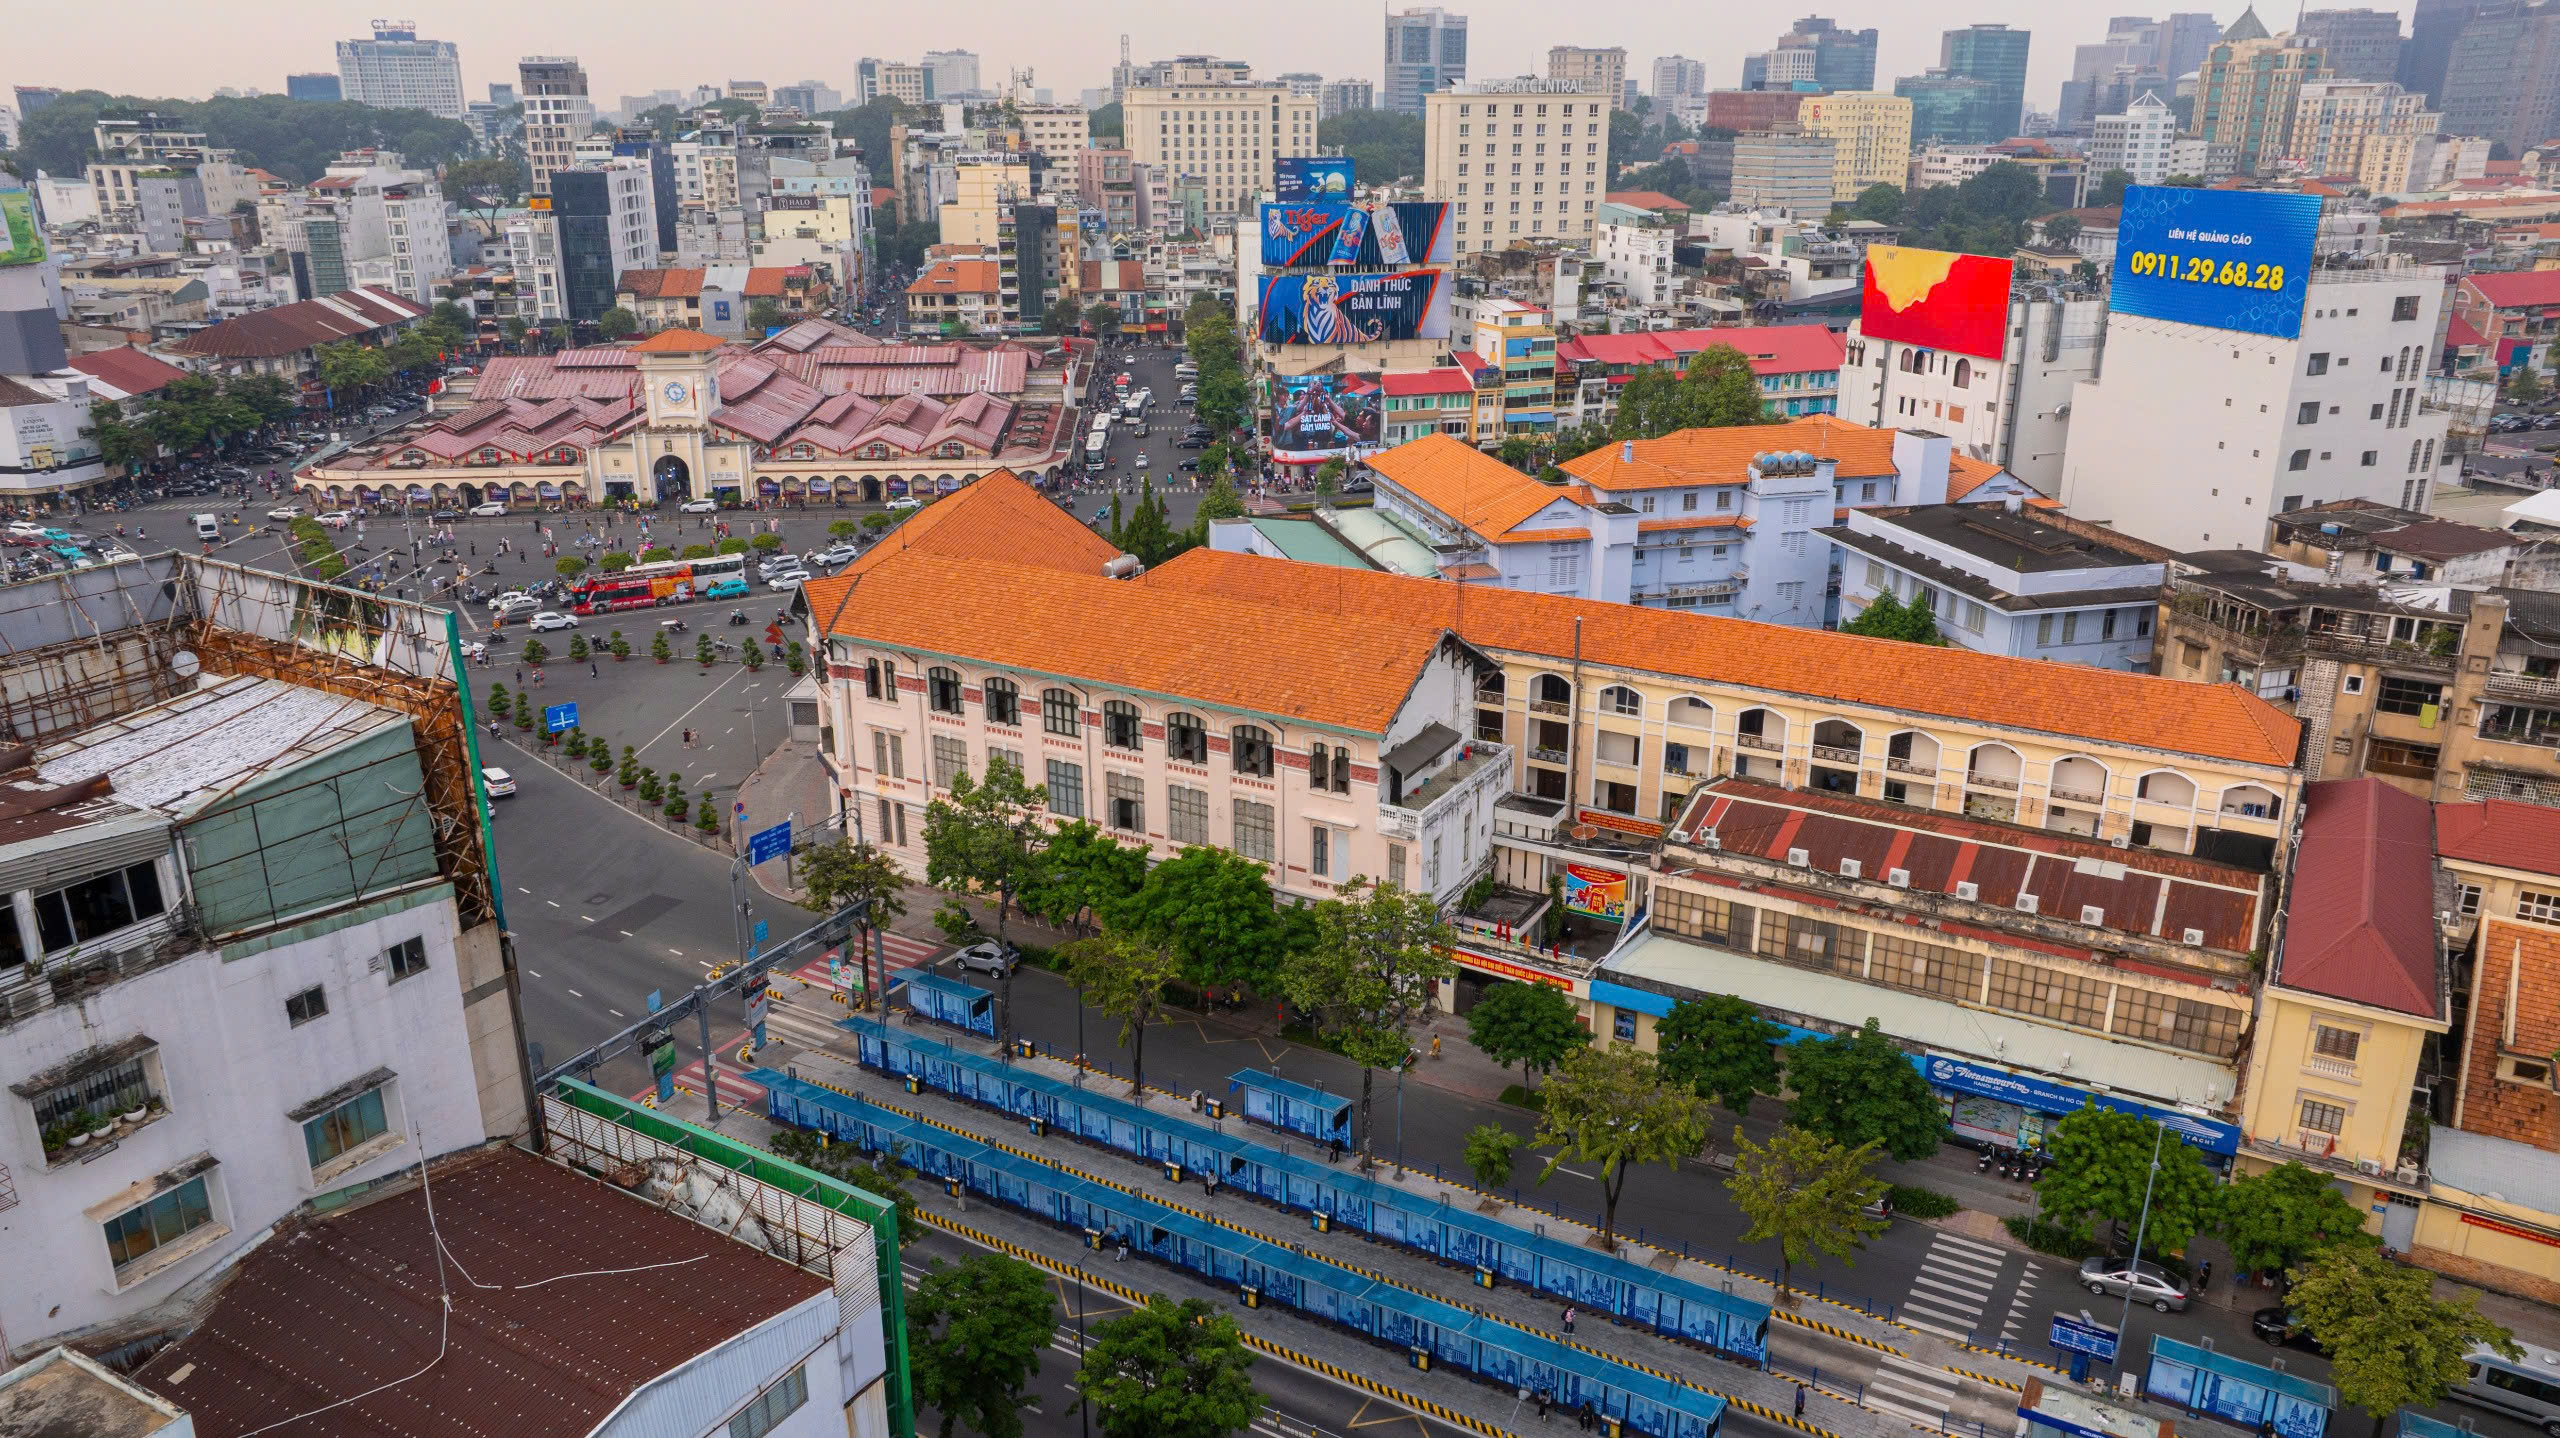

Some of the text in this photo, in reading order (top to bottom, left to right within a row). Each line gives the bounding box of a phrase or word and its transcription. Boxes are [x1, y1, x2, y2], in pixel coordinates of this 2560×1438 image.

[1480, 79, 1585, 93] LIBERTY CENTRAL
[1285, 208, 1330, 232] Tiger
[2168, 228, 2252, 245] LIÊN HỆ QUẢNG CÁO
[2131, 250, 2284, 291] 0911.29.68.28
[1351, 275, 1411, 292] ĐÁNH THỨC
[1351, 293, 1401, 310] BẢN LĨNH
[1300, 412, 1331, 423] SÁT CÁNH
[1314, 422, 1331, 431] VANG
[1954, 1066, 2030, 1094] Vietnamtourism
[2033, 1089, 2058, 1101] BRANCH
[2058, 1094, 2065, 1102] IN
[2065, 1096, 2075, 1104] HO
[1973, 1080, 1991, 1089] HANOI
